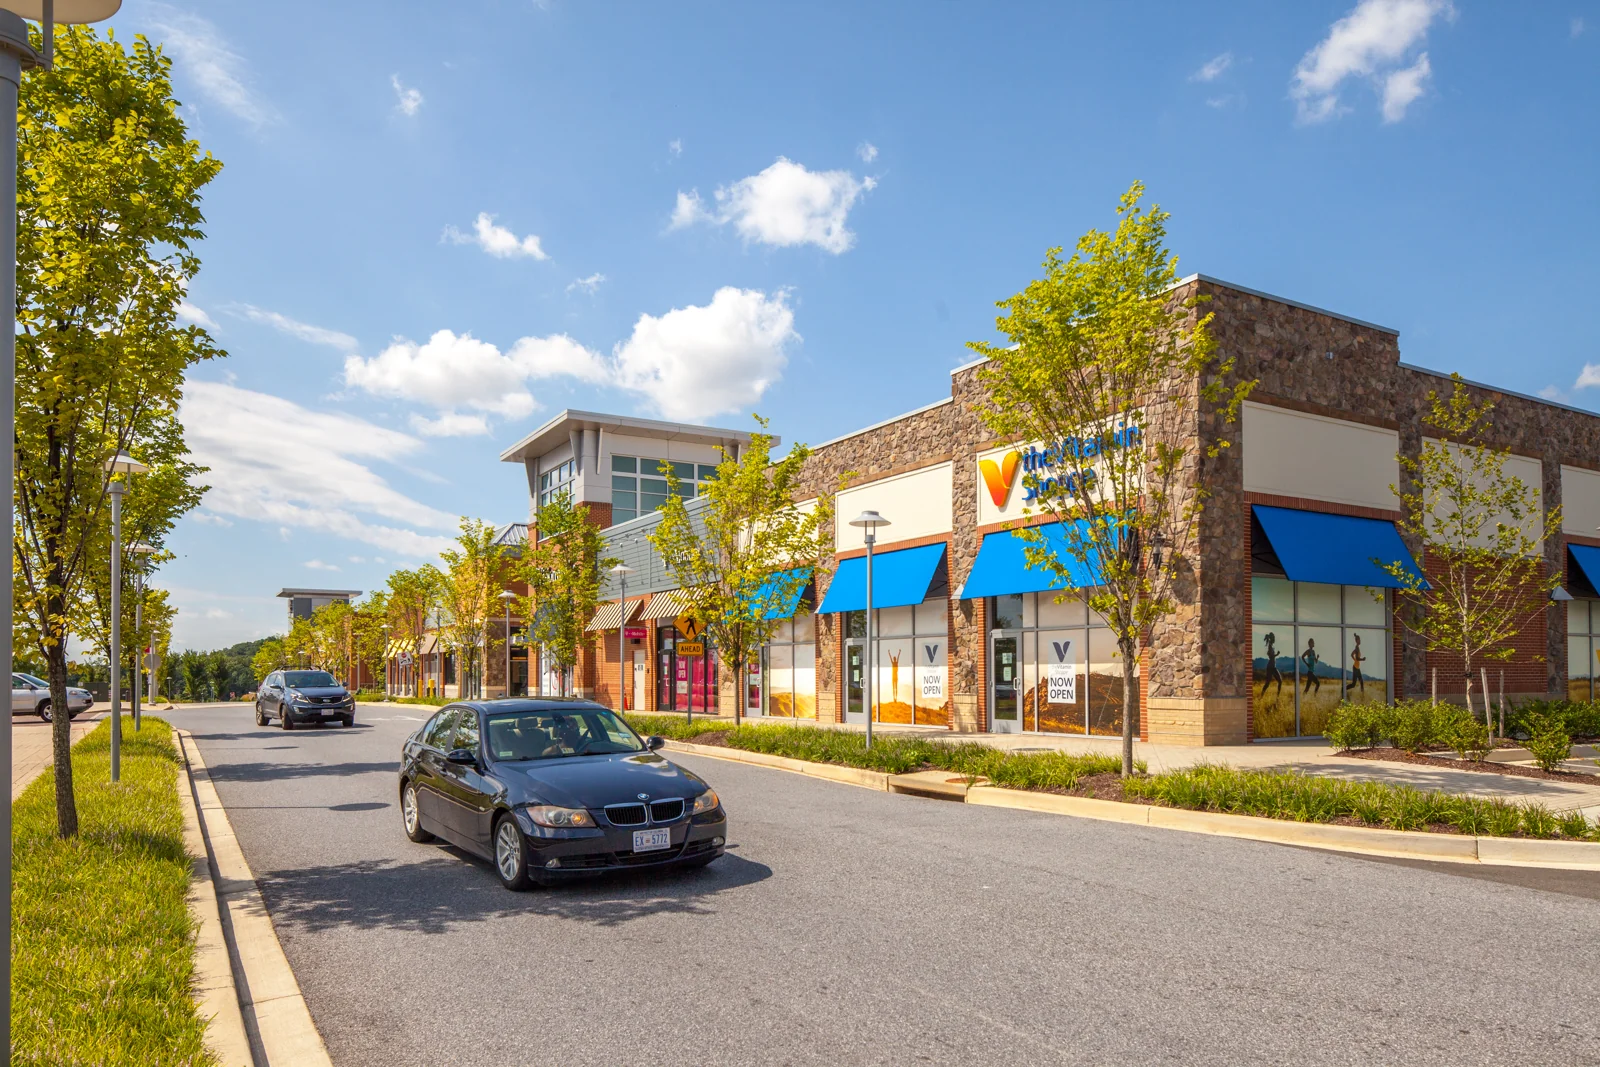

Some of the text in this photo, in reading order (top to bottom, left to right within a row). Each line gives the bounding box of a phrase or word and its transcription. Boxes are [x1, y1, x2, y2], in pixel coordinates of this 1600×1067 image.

[680, 644, 700, 653] AHEAD
[923, 675, 941, 684] NOW
[1050, 677, 1073, 687] NOW
[923, 685, 941, 695] OPEN
[1050, 689, 1074, 700] OPEN
[635, 833, 668, 846] EX 5772
